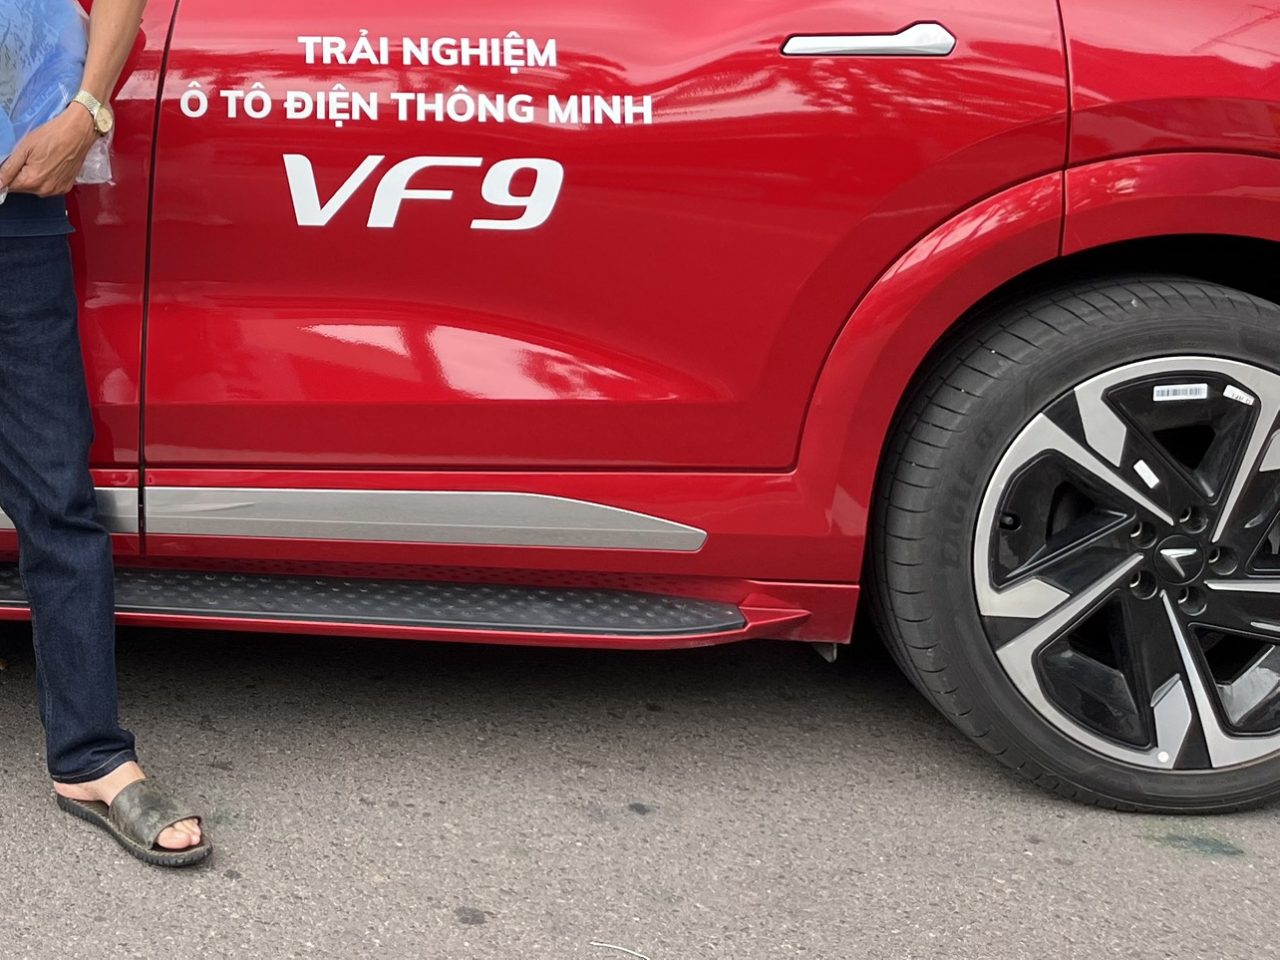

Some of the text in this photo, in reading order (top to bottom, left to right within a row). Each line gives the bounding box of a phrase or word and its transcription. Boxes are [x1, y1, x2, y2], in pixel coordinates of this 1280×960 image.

[297, 29, 557, 74] TRẢI NGHIỆM
[180, 81, 653, 128] Ô TÔ ĐIỆN THÔNG MINH
